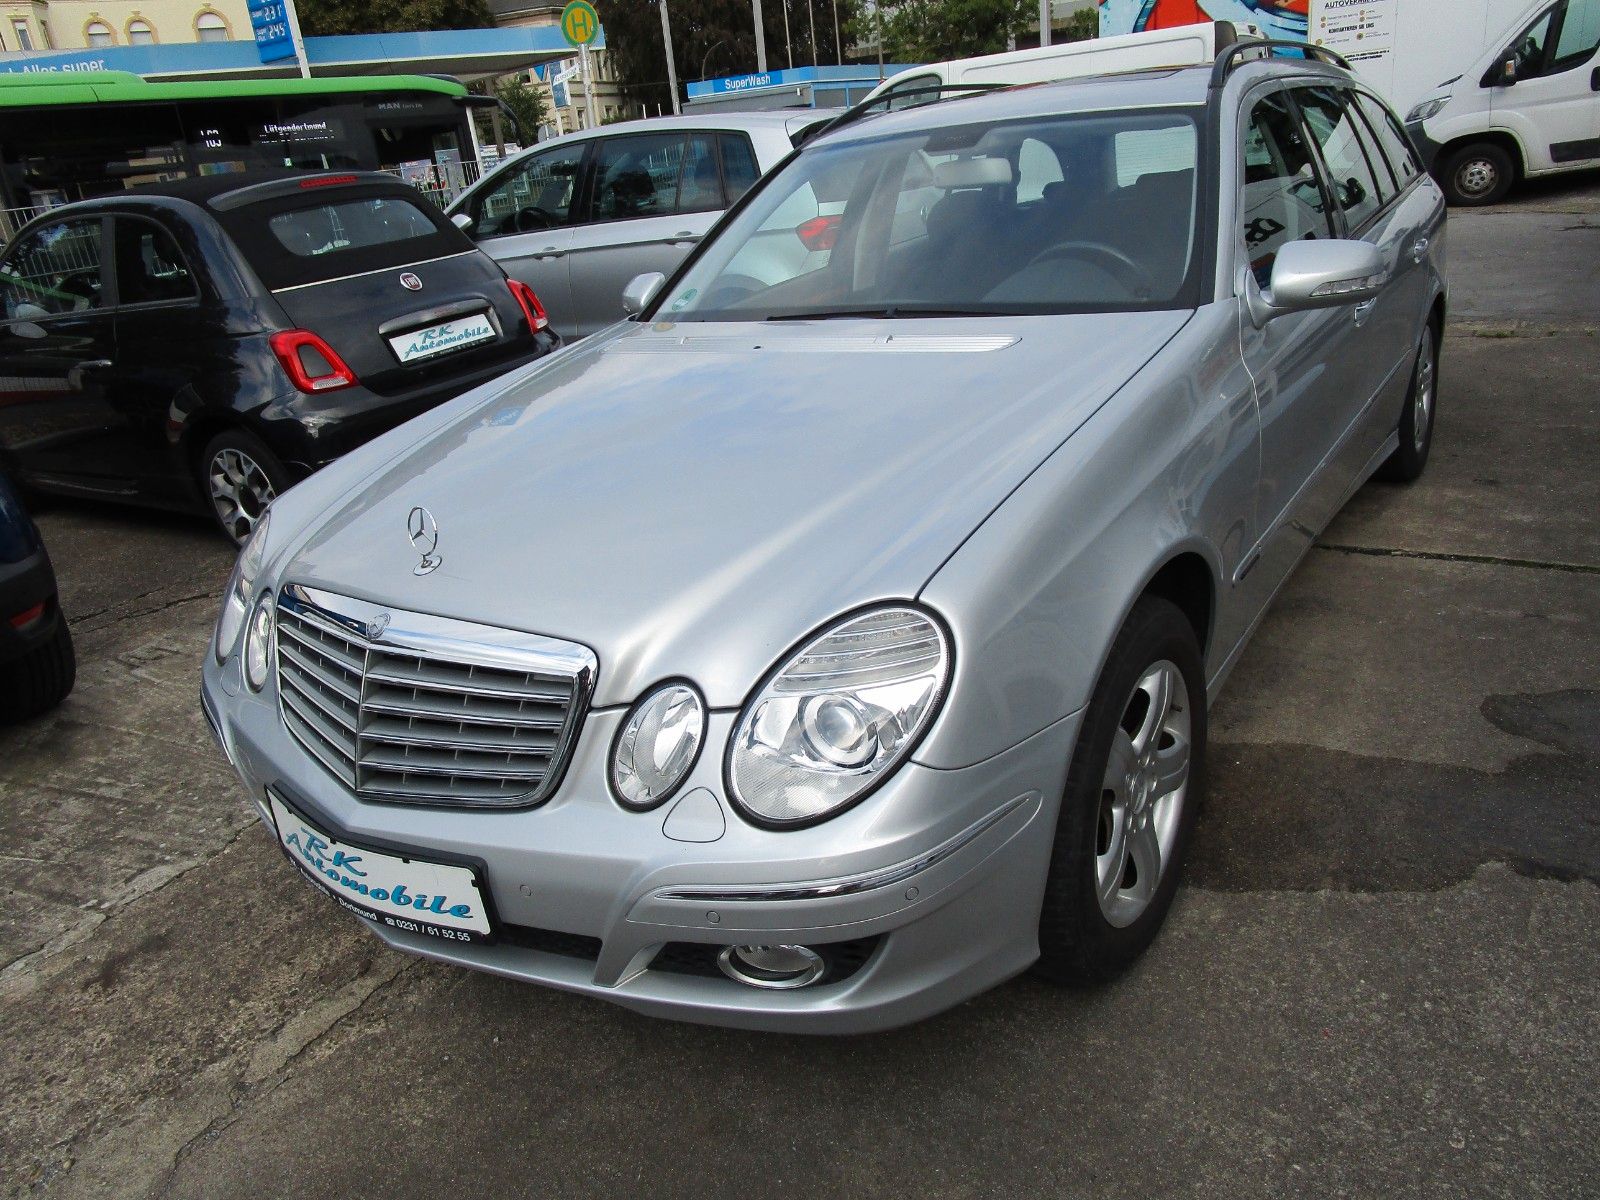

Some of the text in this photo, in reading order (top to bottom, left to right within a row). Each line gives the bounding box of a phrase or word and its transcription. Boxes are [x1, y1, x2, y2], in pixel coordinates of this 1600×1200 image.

[725, 74, 771, 90] SuperWash
[404, 325, 490, 359] Automobile
[418, 324, 454, 344] RK
[301, 827, 367, 877] RK
[285, 831, 474, 919] Automobile
[339, 897, 378, 921] Dortmund
[396, 919, 419, 932] 0231
[427, 926, 440, 937] 61
[441, 929, 456, 940] 52
[457, 931, 471, 942] 55
